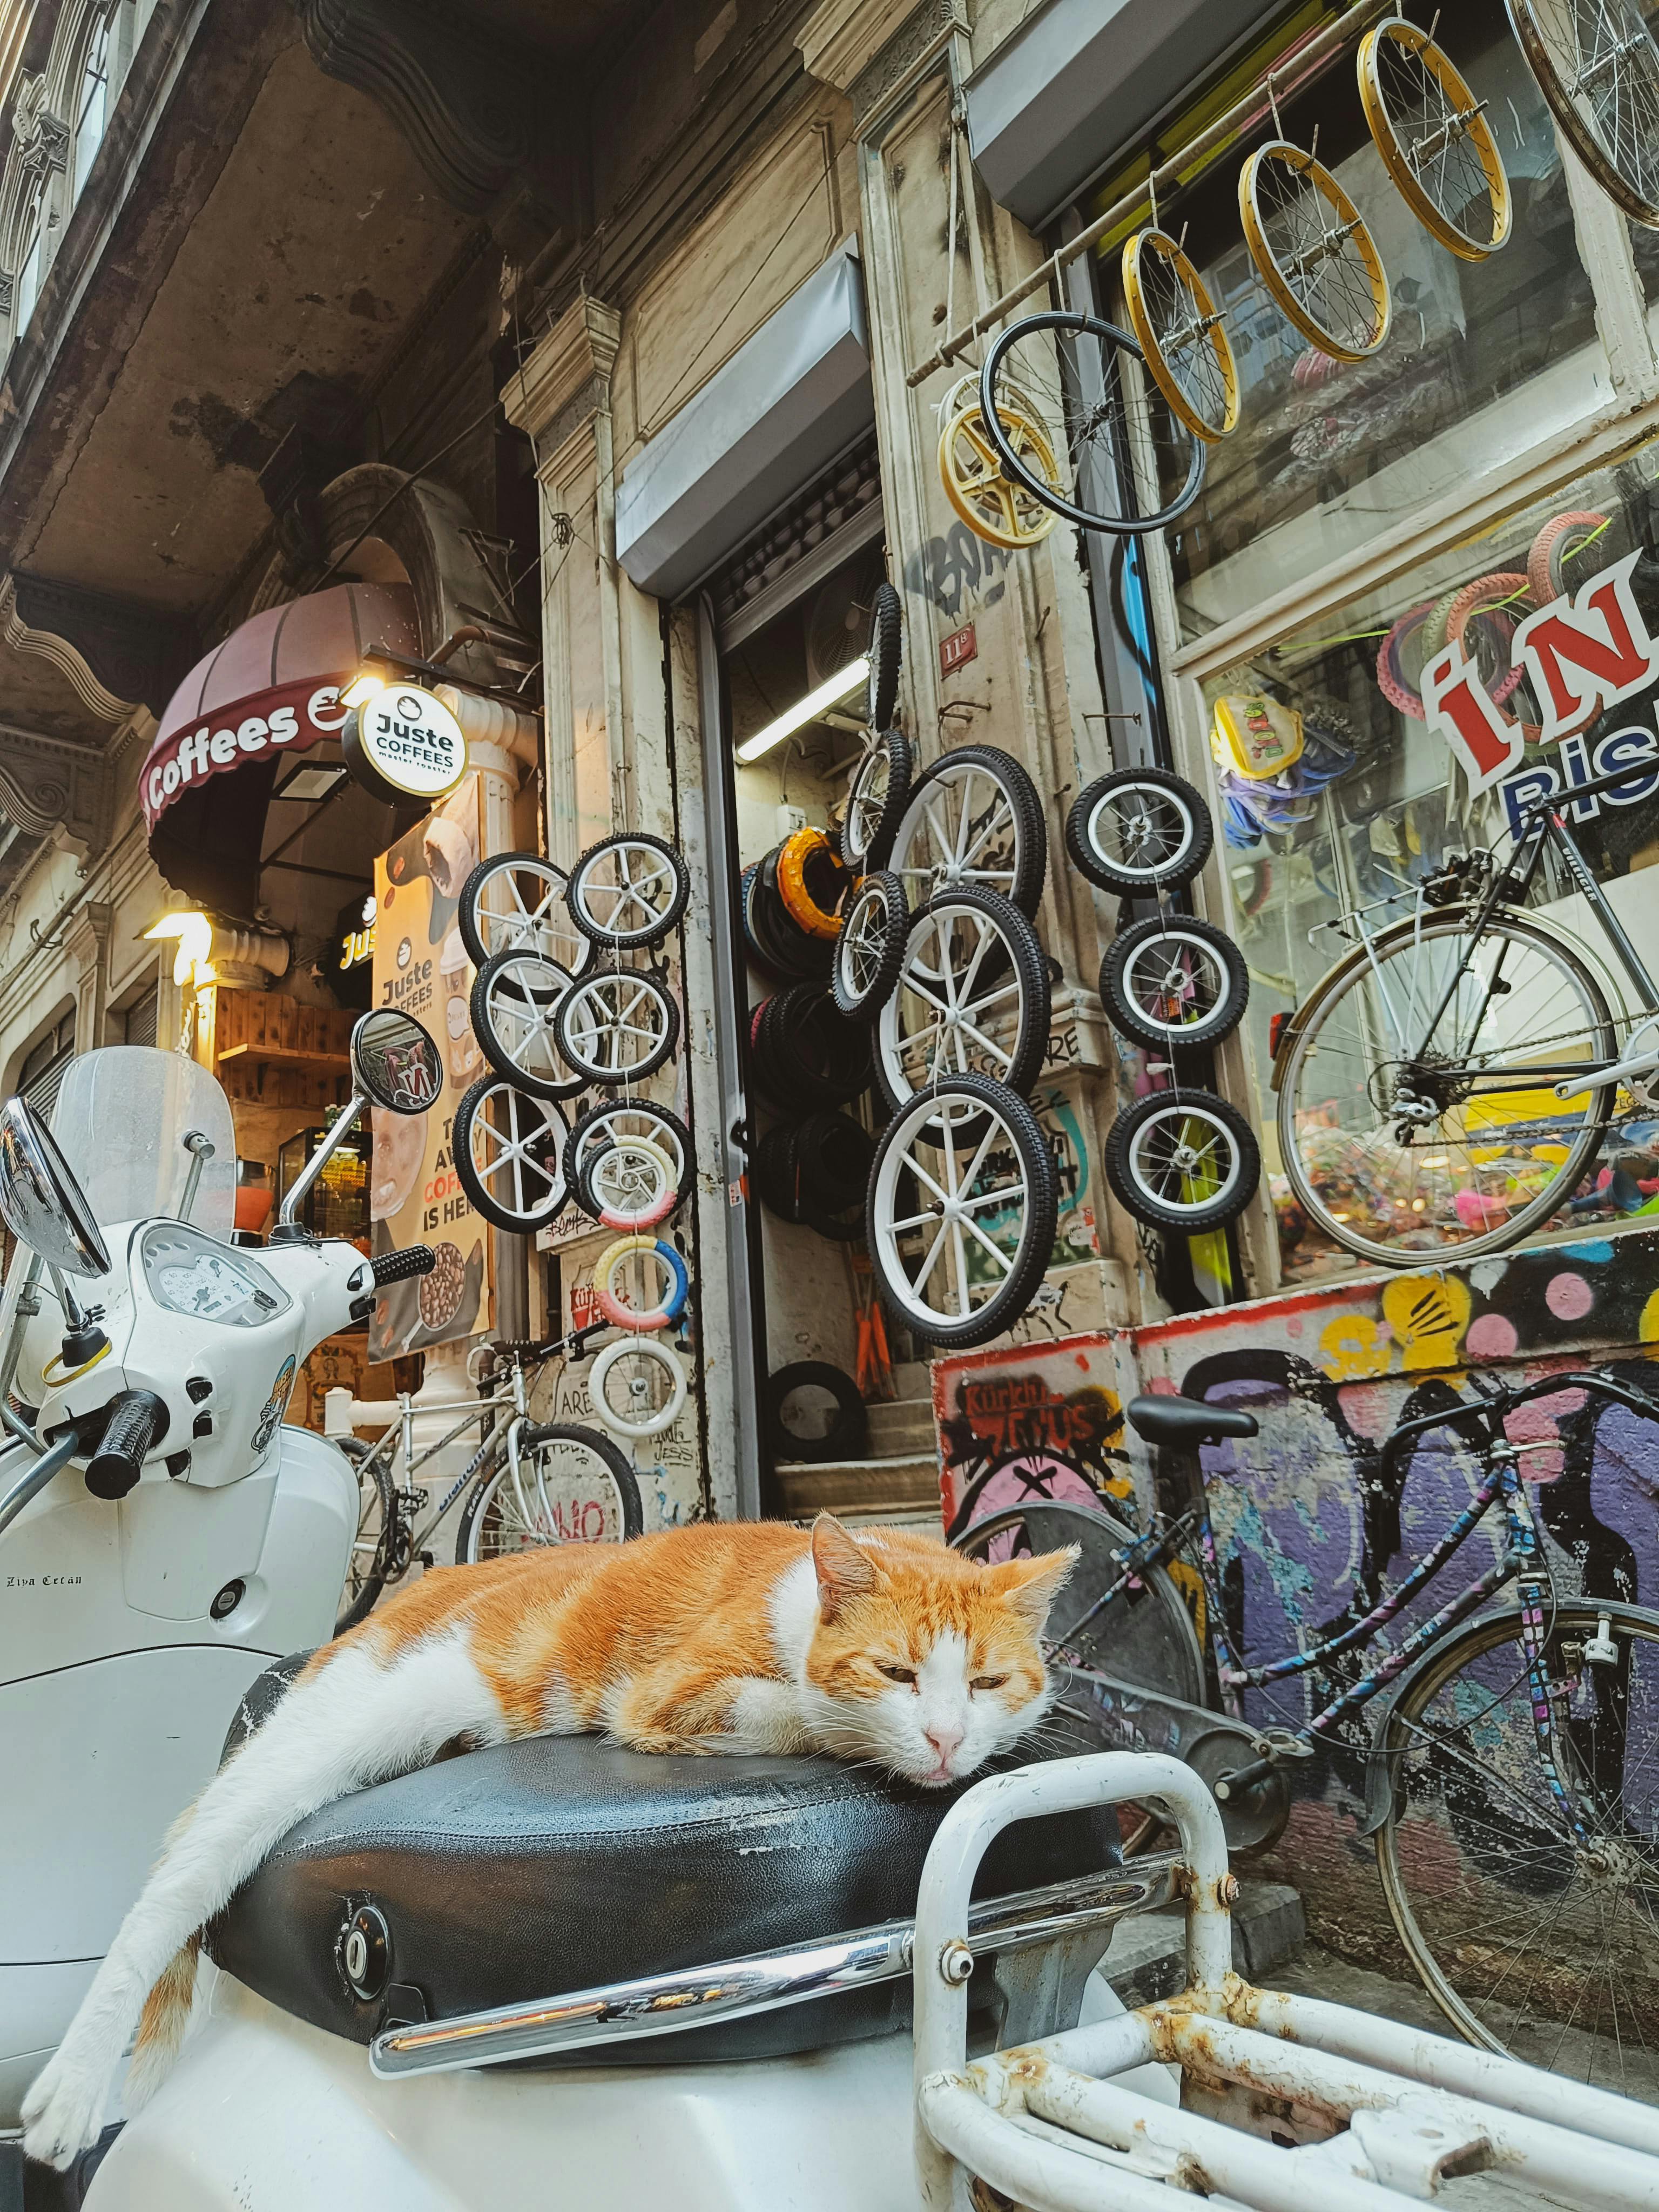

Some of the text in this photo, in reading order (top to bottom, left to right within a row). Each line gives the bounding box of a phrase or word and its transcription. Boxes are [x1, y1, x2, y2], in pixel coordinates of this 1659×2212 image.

[376, 713, 454, 752] Juste
[376, 737, 453, 767] COFFEES
[149, 706, 299, 810] Coffees
[379, 751, 450, 774] master roaster
[1562, 847, 1597, 901] VILLIGER
[382, 959, 433, 1006] Juste
[424, 1208, 439, 1231] IS
